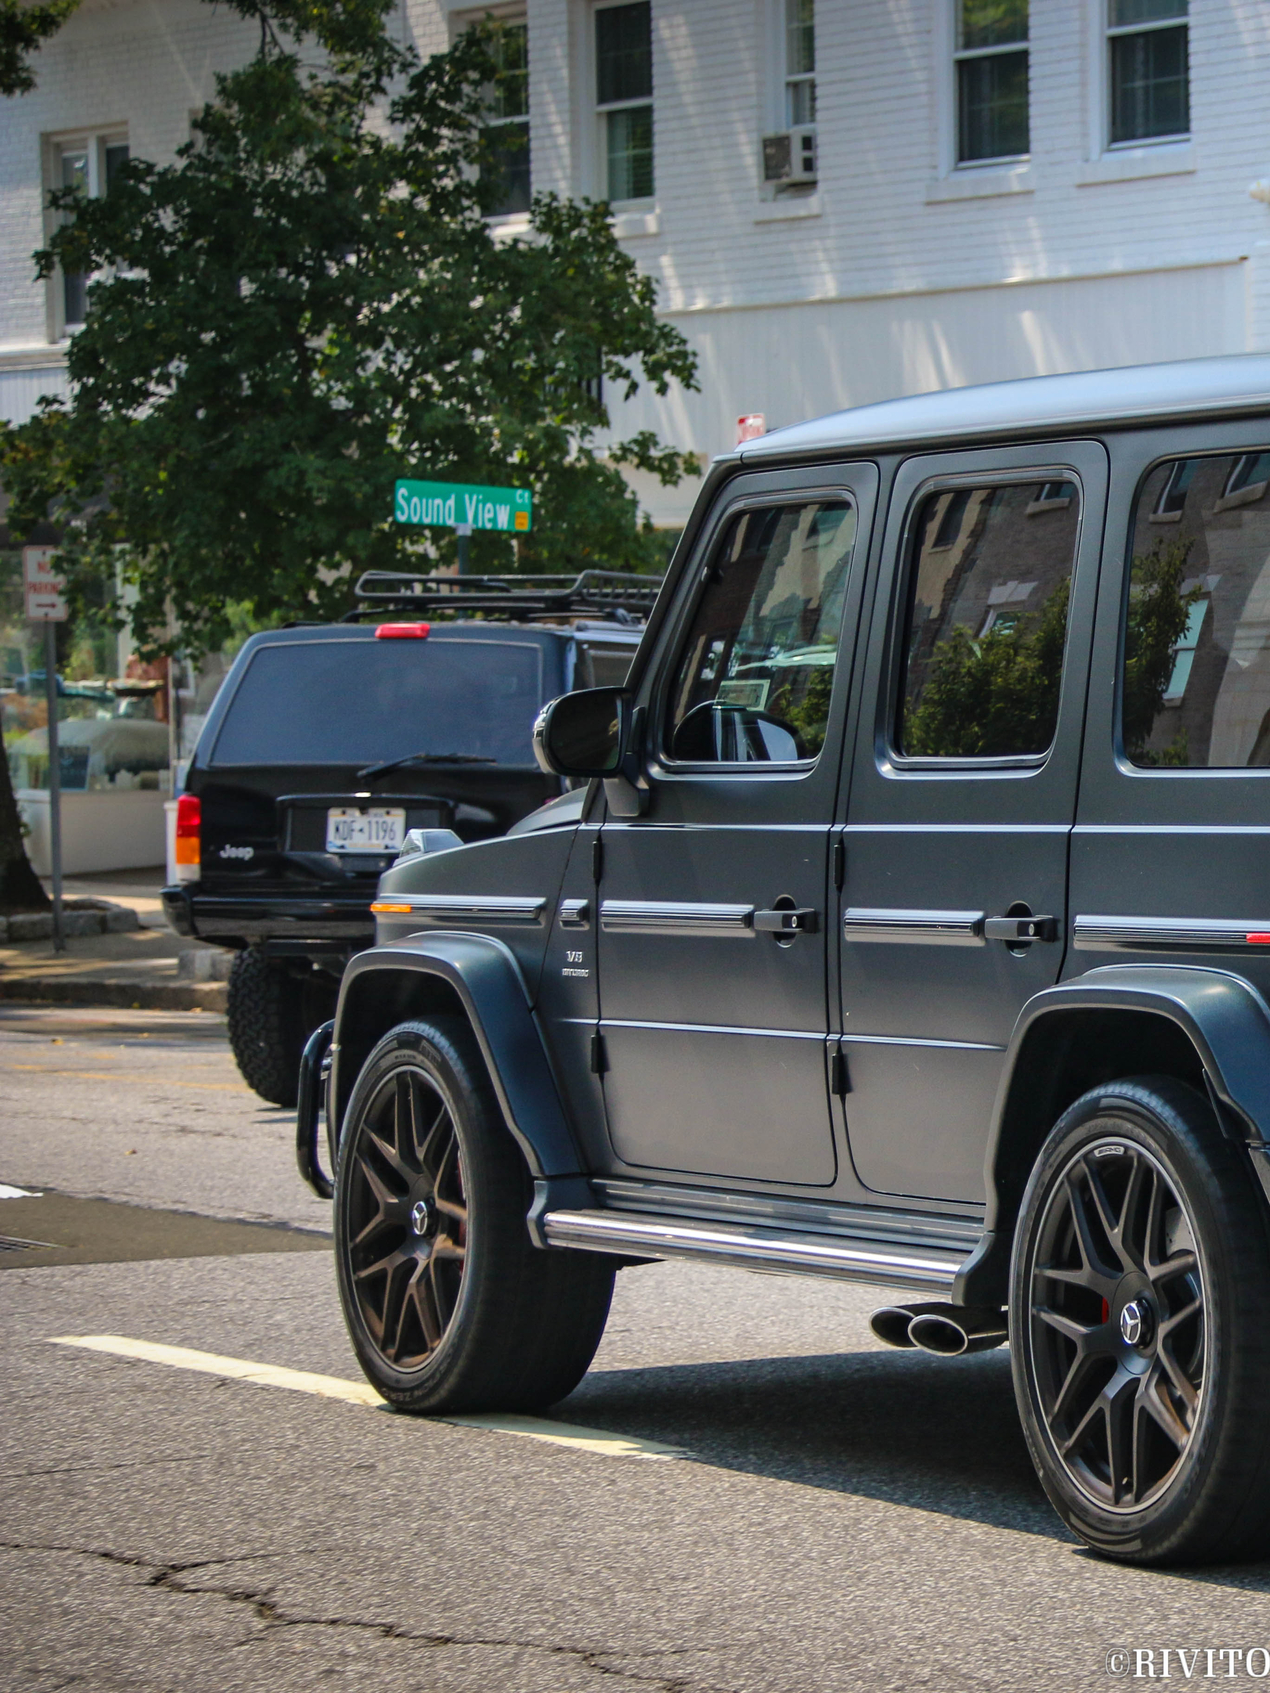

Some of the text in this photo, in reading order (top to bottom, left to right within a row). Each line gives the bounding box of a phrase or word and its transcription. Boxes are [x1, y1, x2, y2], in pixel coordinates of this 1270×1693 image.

[396, 487, 456, 525] Sound
[464, 493, 510, 530] View
[515, 489, 529, 503] Ct
[367, 820, 396, 841] 1196
[219, 844, 254, 861] Jeep
[566, 950, 583, 963] V8
